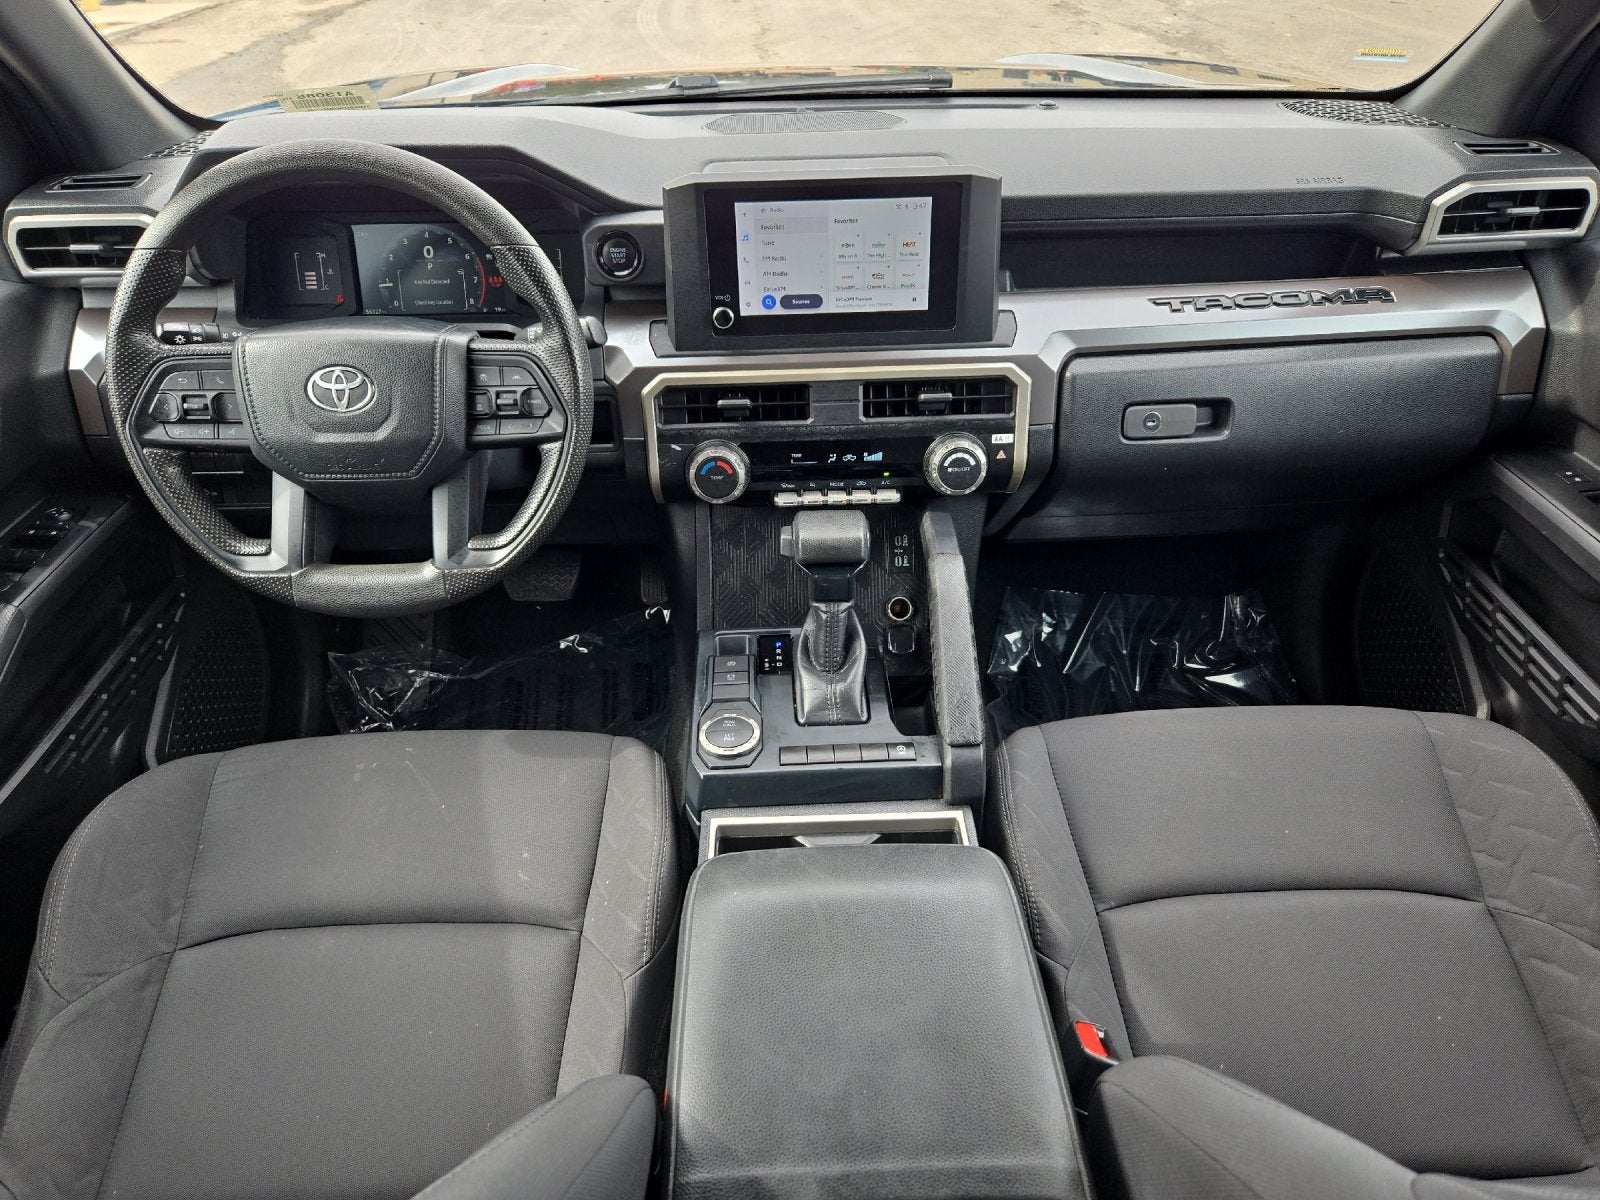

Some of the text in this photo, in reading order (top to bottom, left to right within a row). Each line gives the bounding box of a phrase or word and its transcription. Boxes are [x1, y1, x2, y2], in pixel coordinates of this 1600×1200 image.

[423, 245, 434, 259] 0
[427, 262, 433, 270] P
[1147, 286, 1398, 313] TACOMA
